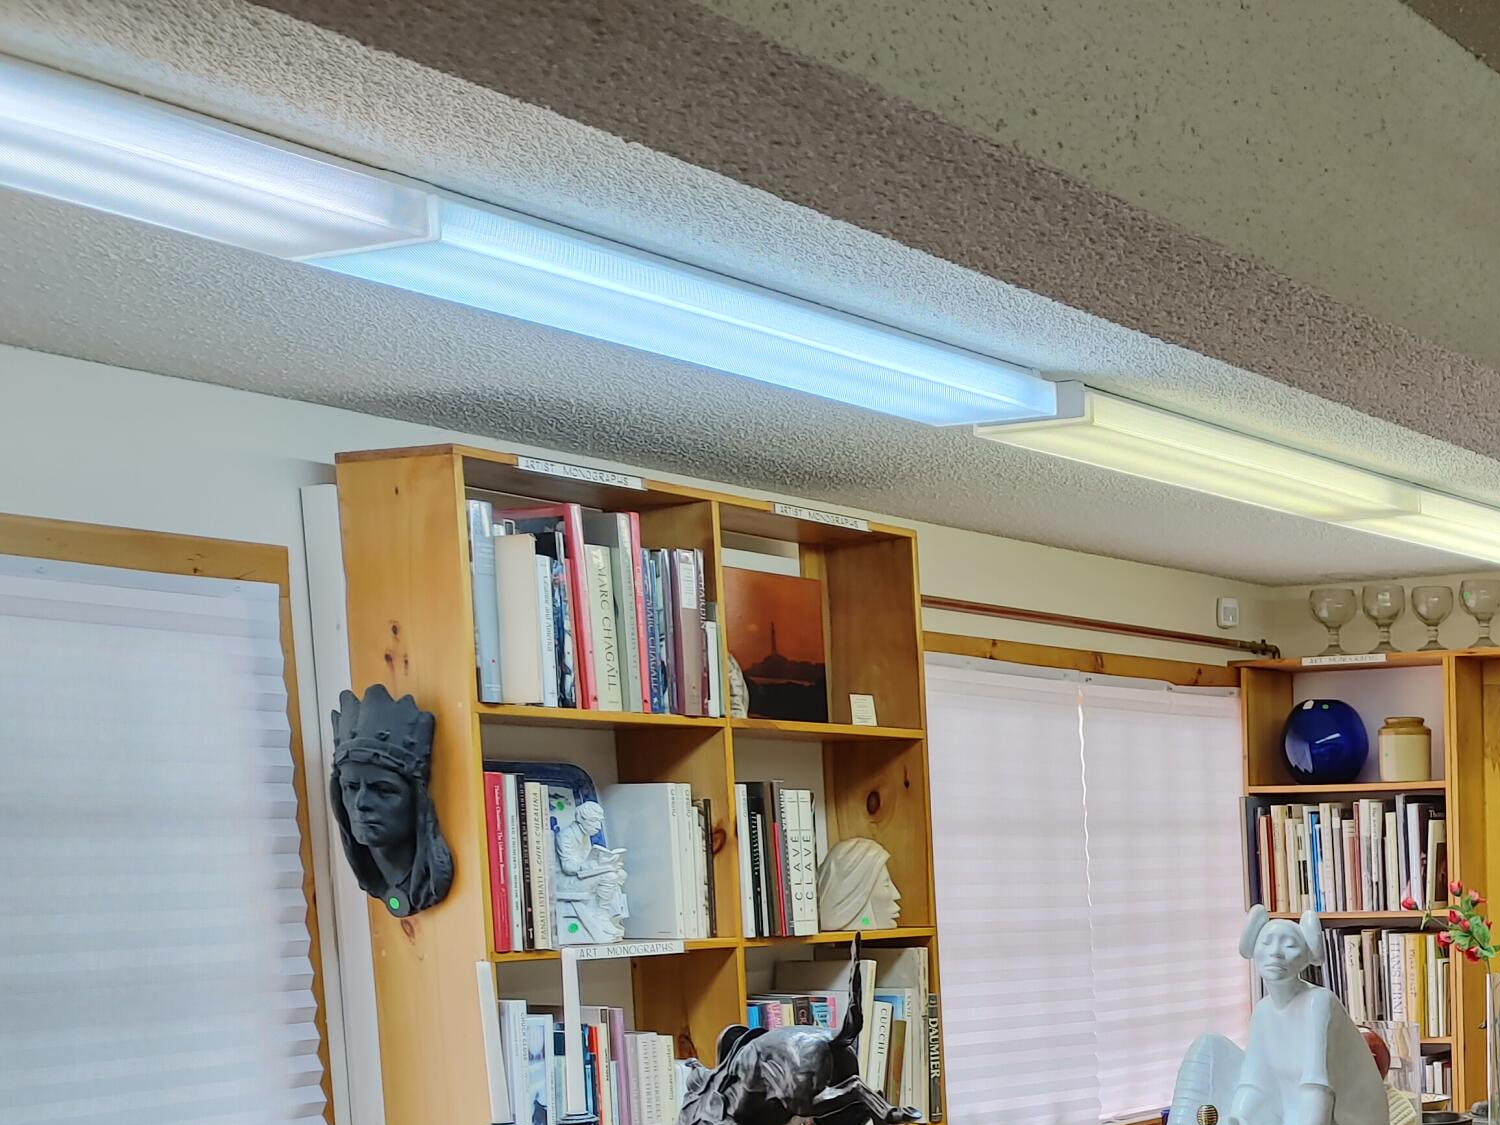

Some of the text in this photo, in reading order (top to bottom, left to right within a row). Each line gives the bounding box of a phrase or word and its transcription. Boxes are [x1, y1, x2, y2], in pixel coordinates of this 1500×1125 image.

[525, 458, 629, 485] ARTIST MONOGRAPHS
[601, 616, 617, 690] CHAGALL
[648, 637, 658, 690] CHAGALL
[580, 943, 674, 958] ART MONOGRAPHS
[928, 1017, 941, 1079] DAUMIER
